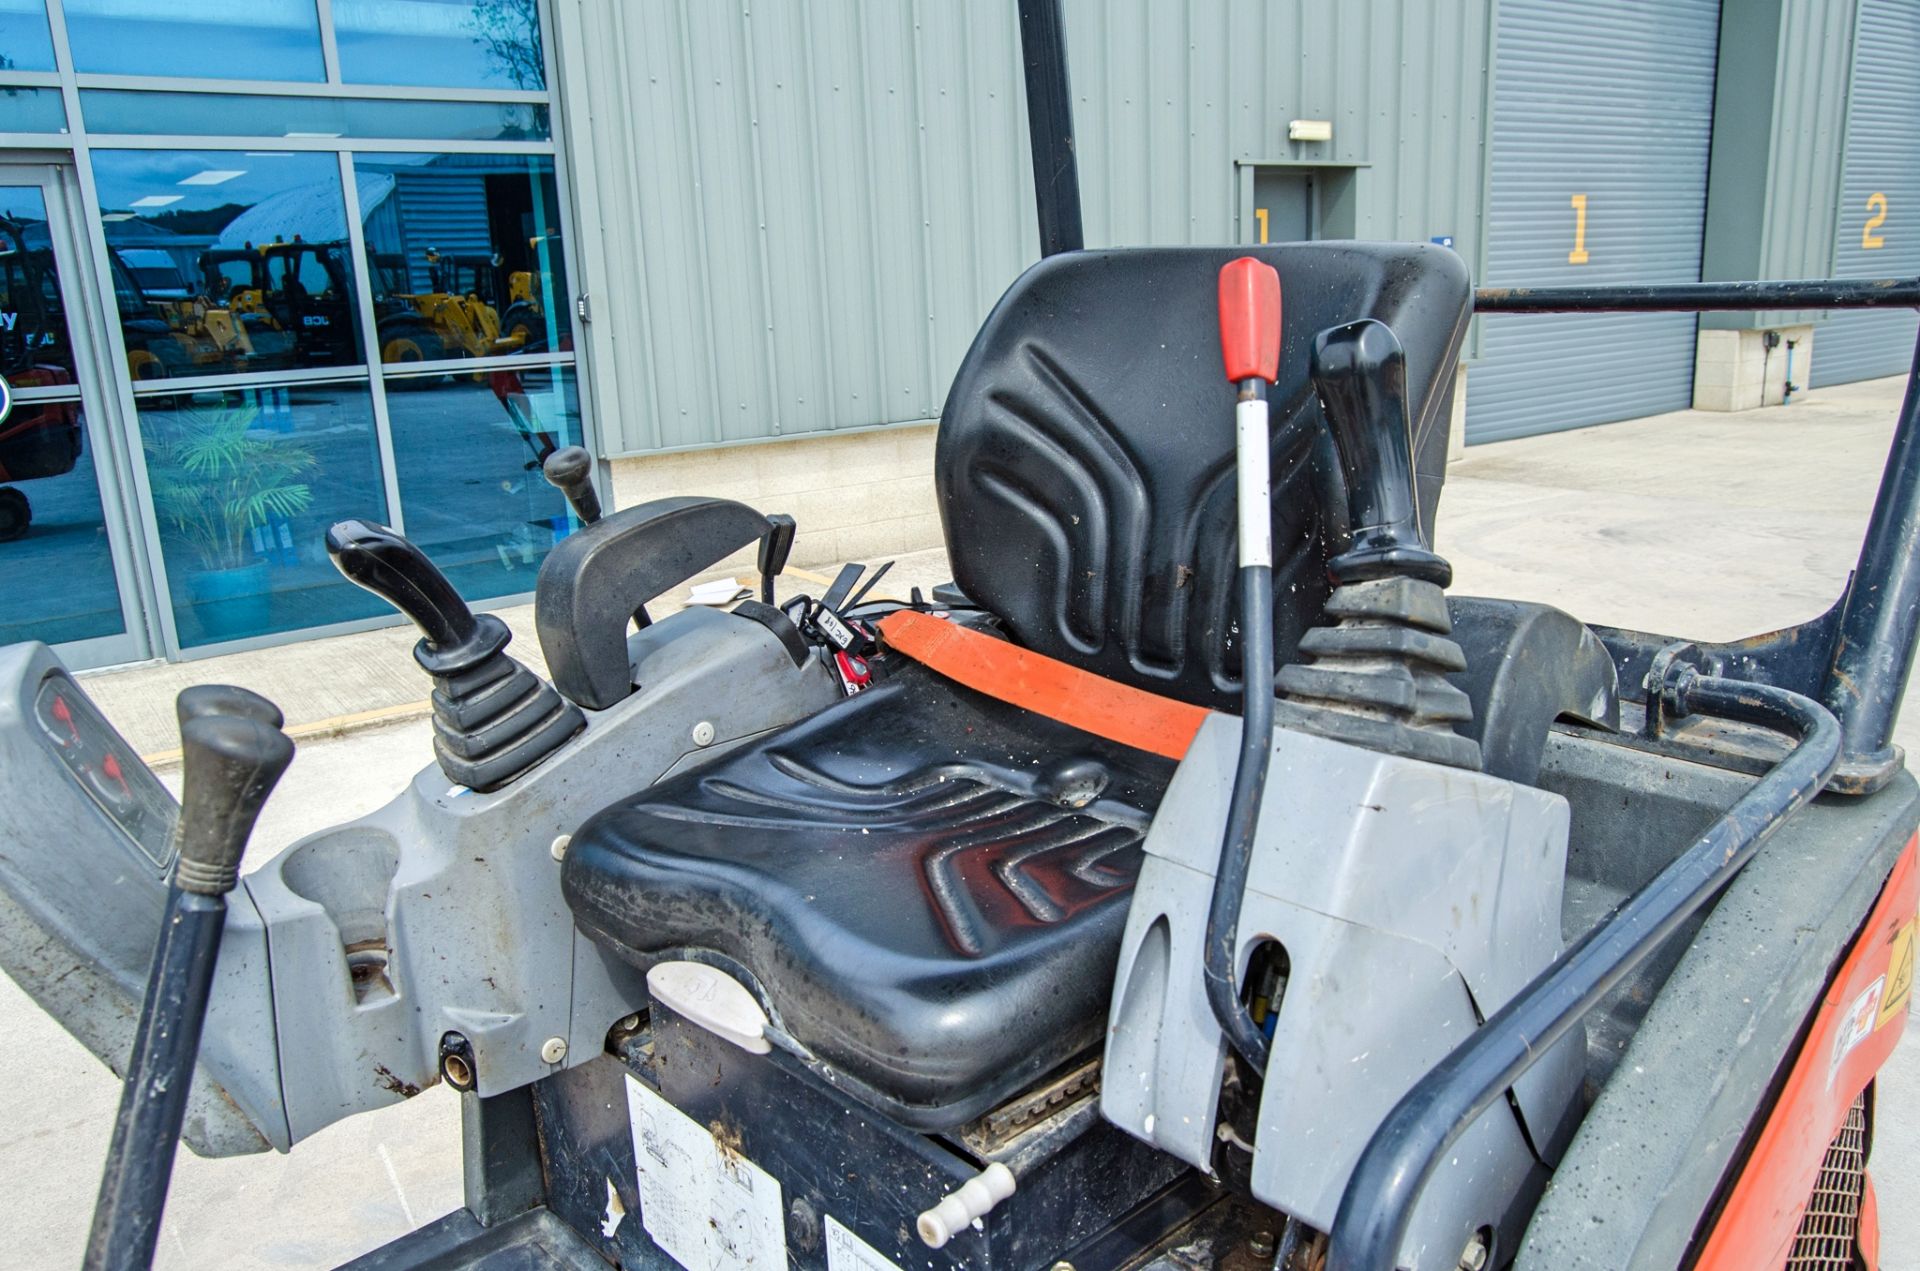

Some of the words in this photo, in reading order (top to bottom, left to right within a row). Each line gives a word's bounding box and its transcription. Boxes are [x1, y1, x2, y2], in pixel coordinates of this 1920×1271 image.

[1255, 208, 1269, 245] 1
[1568, 194, 1589, 264] 1
[1862, 192, 1887, 249] 2
